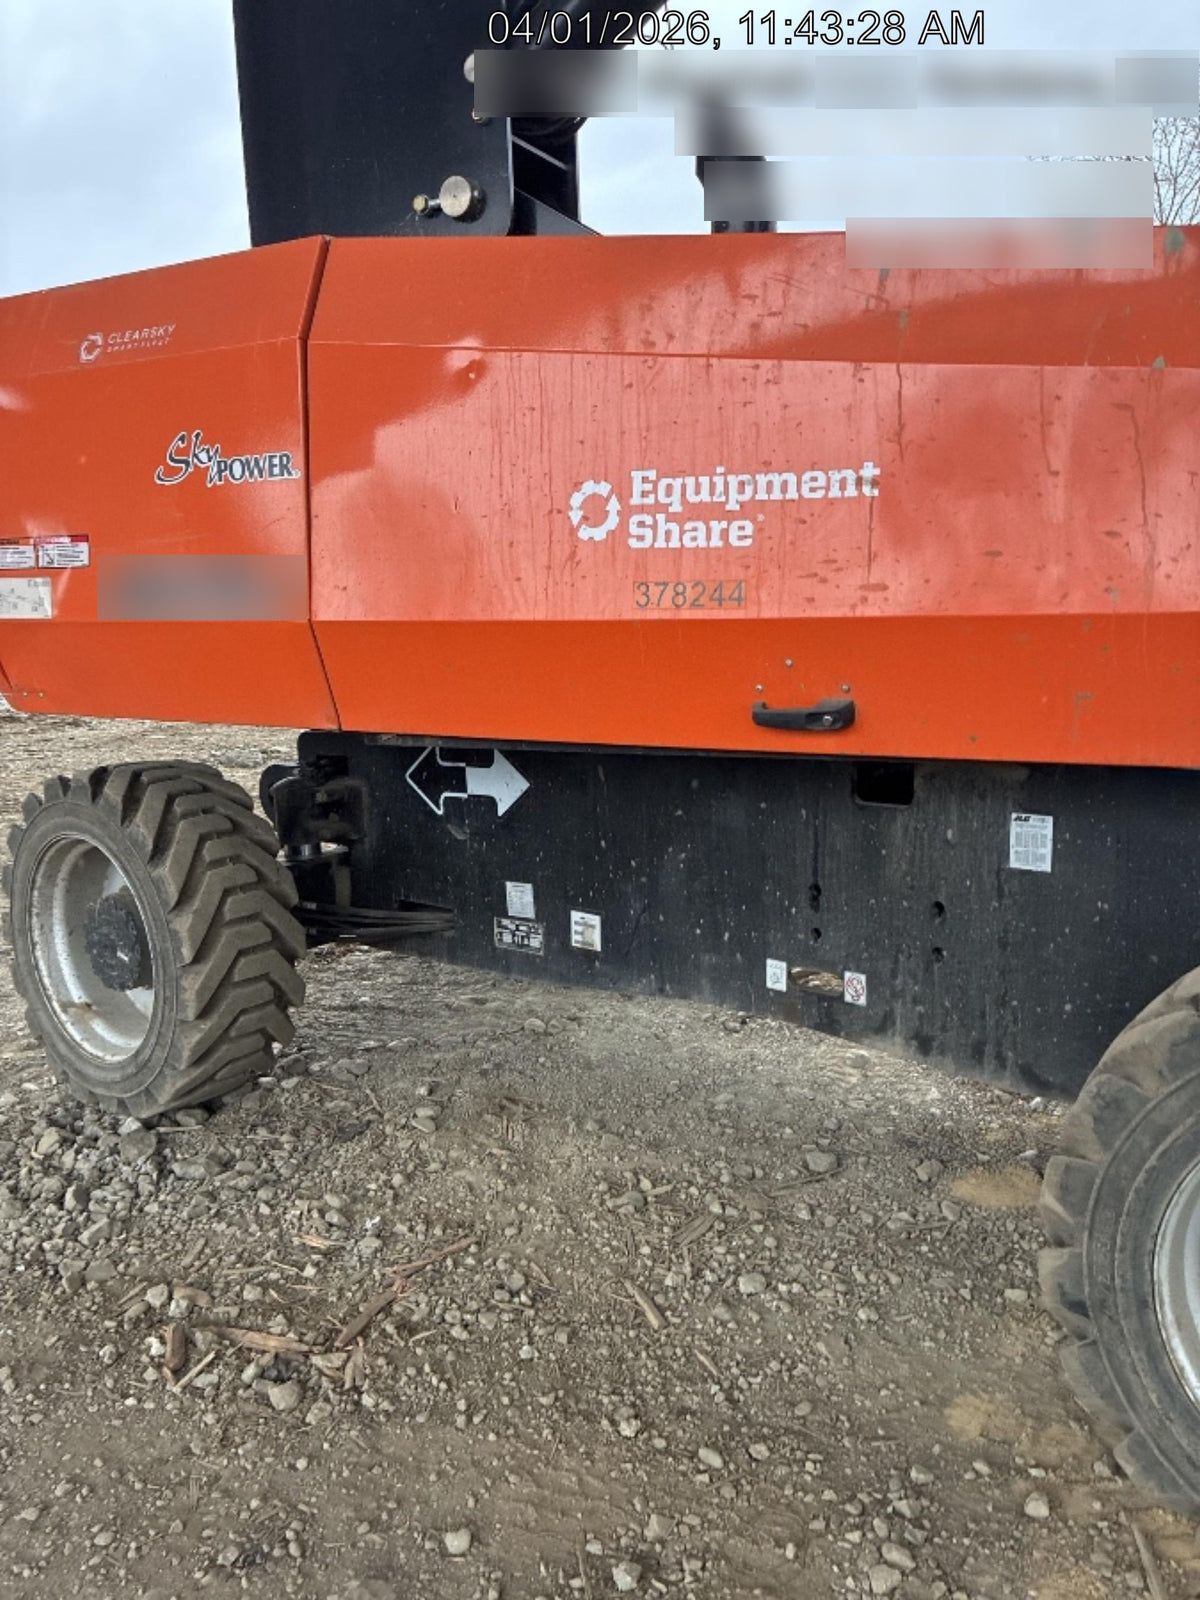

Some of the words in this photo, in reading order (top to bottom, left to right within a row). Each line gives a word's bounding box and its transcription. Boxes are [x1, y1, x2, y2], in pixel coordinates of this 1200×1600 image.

[107, 325, 176, 343] CLEARSKY
[629, 461, 881, 512] Equipment
[627, 513, 753, 548] Share
[635, 581, 745, 608] 378244
